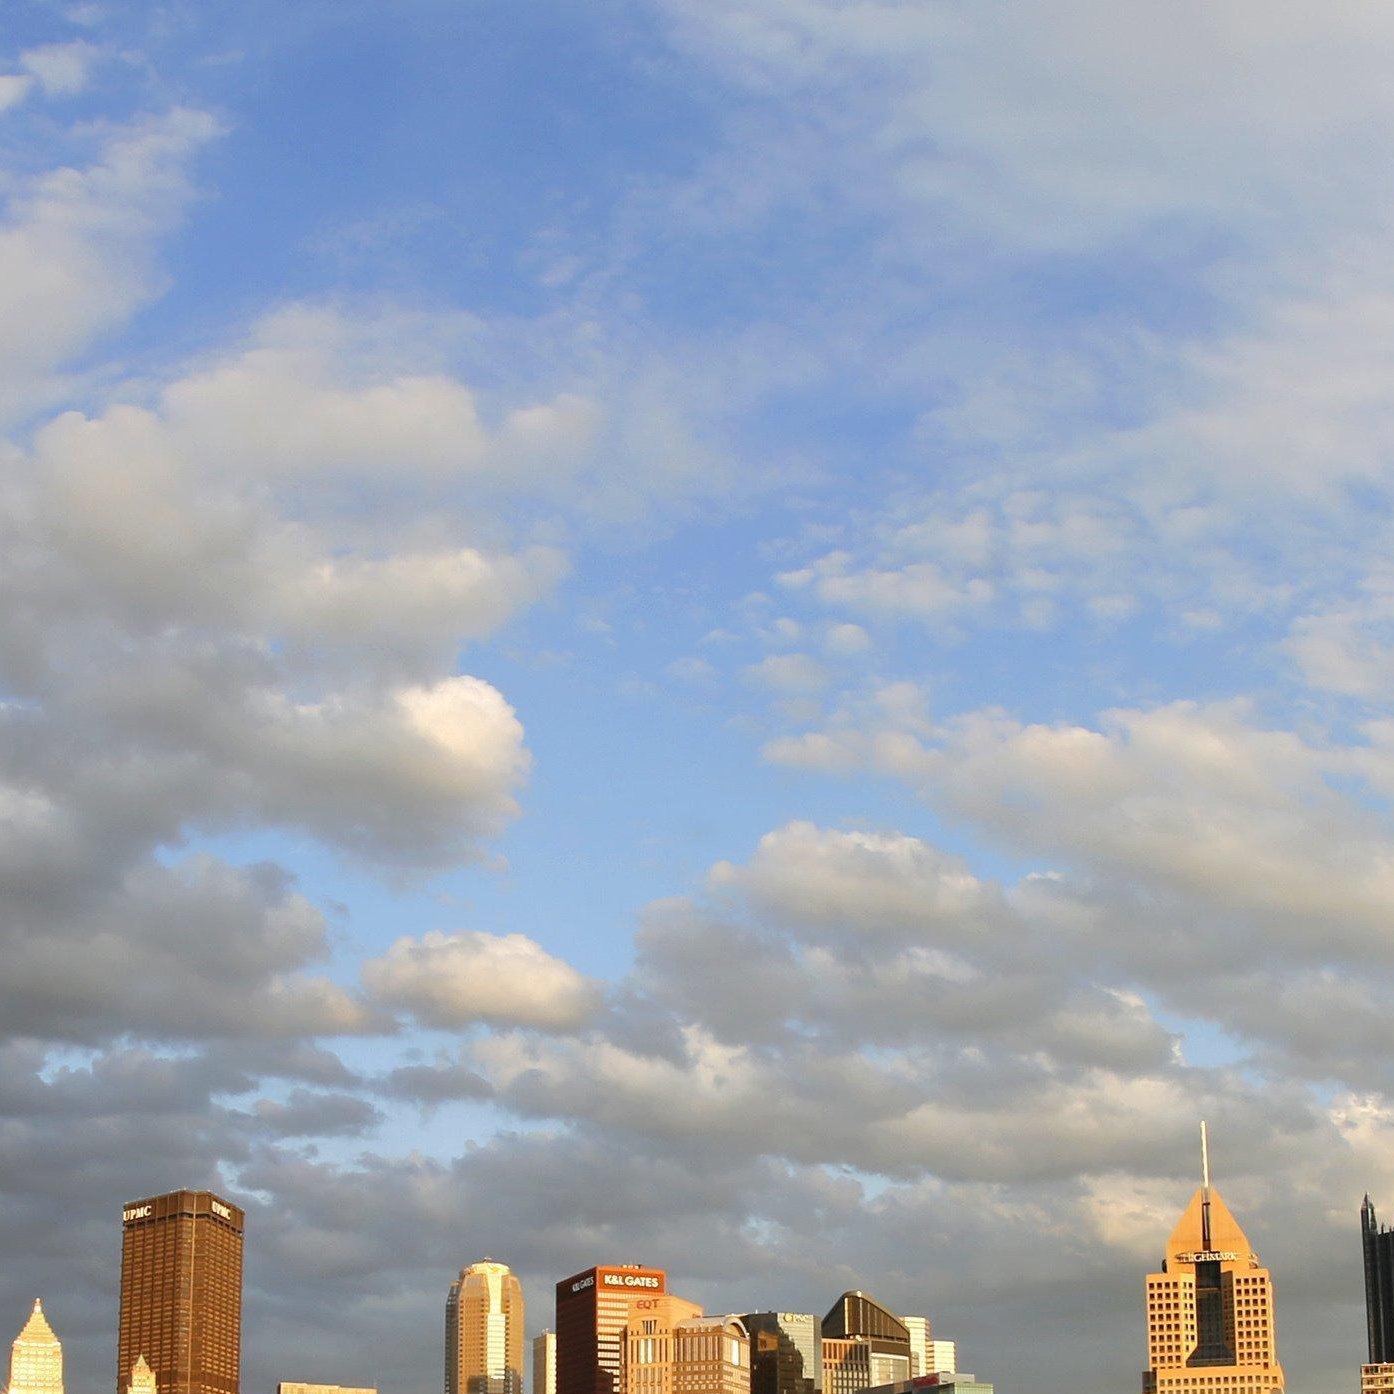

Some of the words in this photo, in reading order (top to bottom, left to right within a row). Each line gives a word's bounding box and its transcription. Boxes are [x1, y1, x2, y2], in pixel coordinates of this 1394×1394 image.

[123, 1205, 152, 1221] UPMC
[212, 1201, 231, 1220] UPMC
[580, 1276, 594, 1290] GATES
[604, 1274, 624, 1286] K&L
[625, 1275, 659, 1288] GATES
[636, 1299, 659, 1310] EQT
